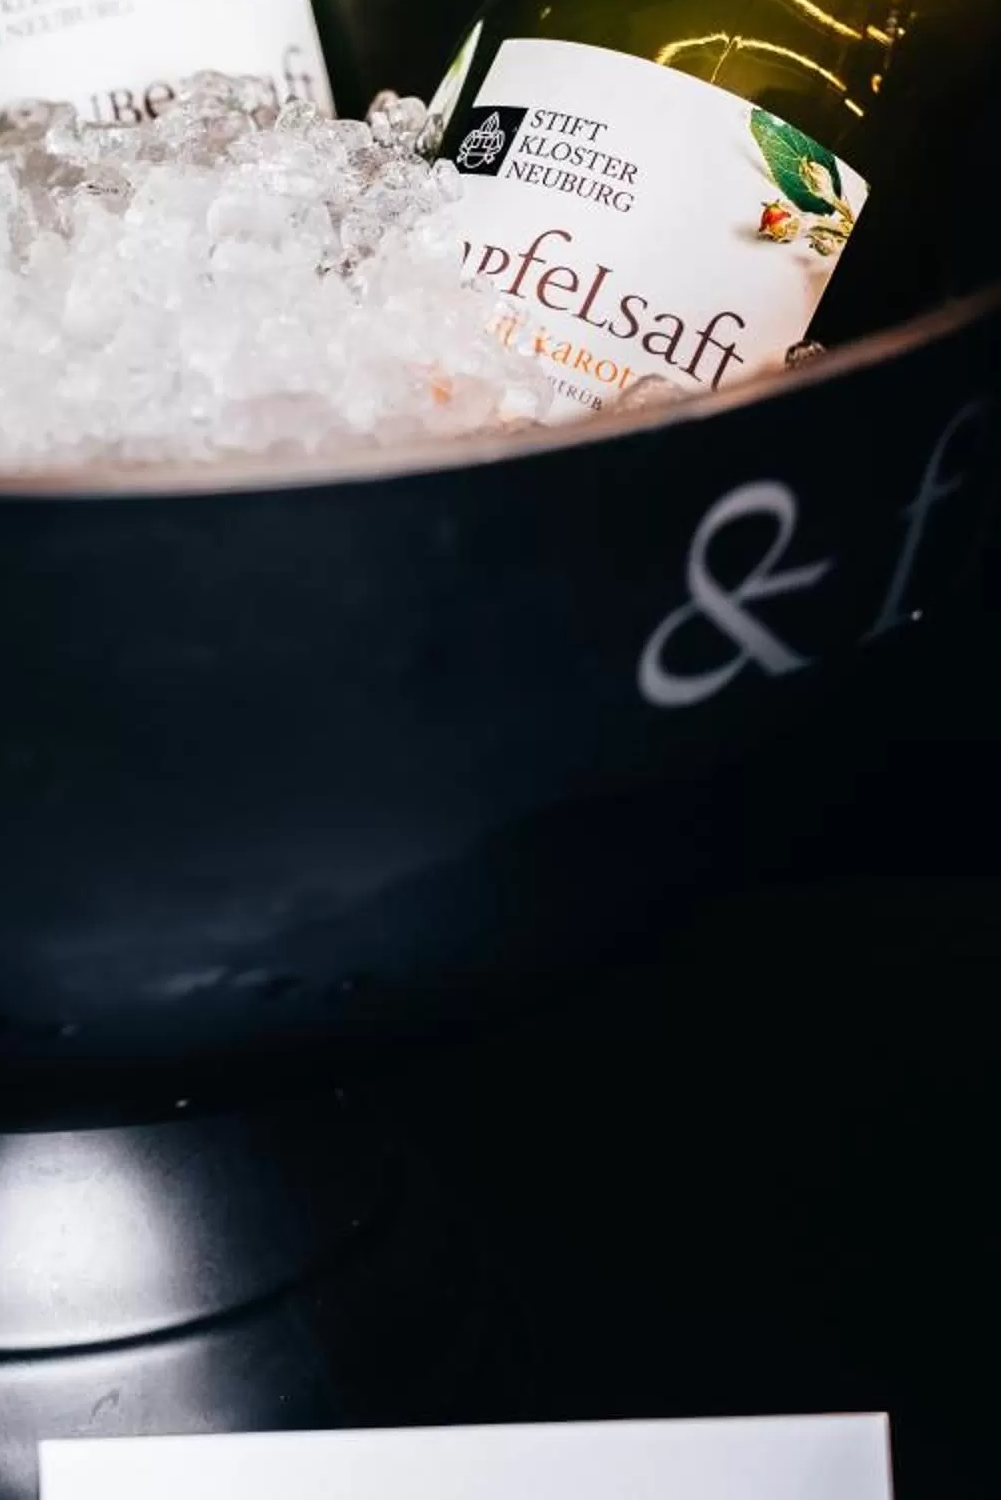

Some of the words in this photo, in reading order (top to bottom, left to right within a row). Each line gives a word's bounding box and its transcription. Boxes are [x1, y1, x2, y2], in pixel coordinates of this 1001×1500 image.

[530, 108, 609, 143] STIFT
[518, 134, 639, 185] KLOSTER
[505, 162, 636, 214] NEUBURG
[636, 478, 835, 708] &
